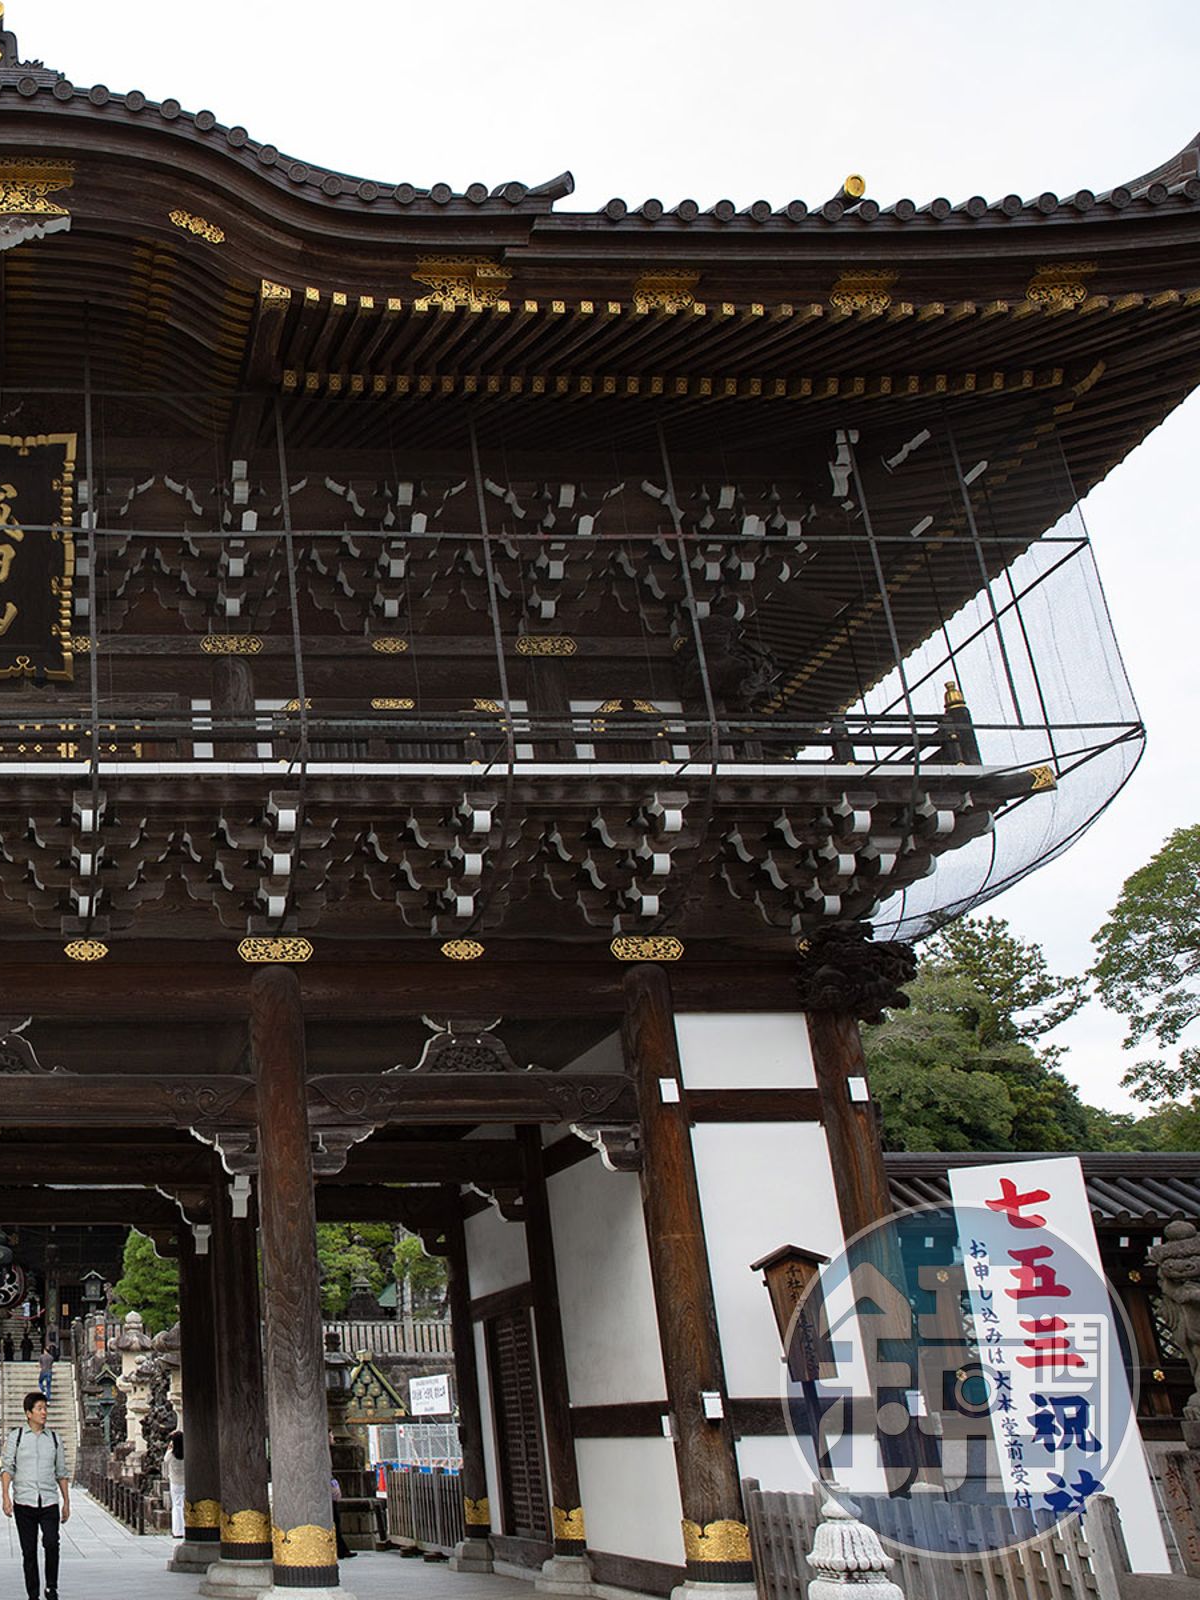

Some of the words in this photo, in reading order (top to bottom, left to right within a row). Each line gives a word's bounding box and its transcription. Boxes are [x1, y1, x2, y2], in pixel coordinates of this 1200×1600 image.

[969, 1239, 1033, 1509] お申し込みは大本堂前受付
